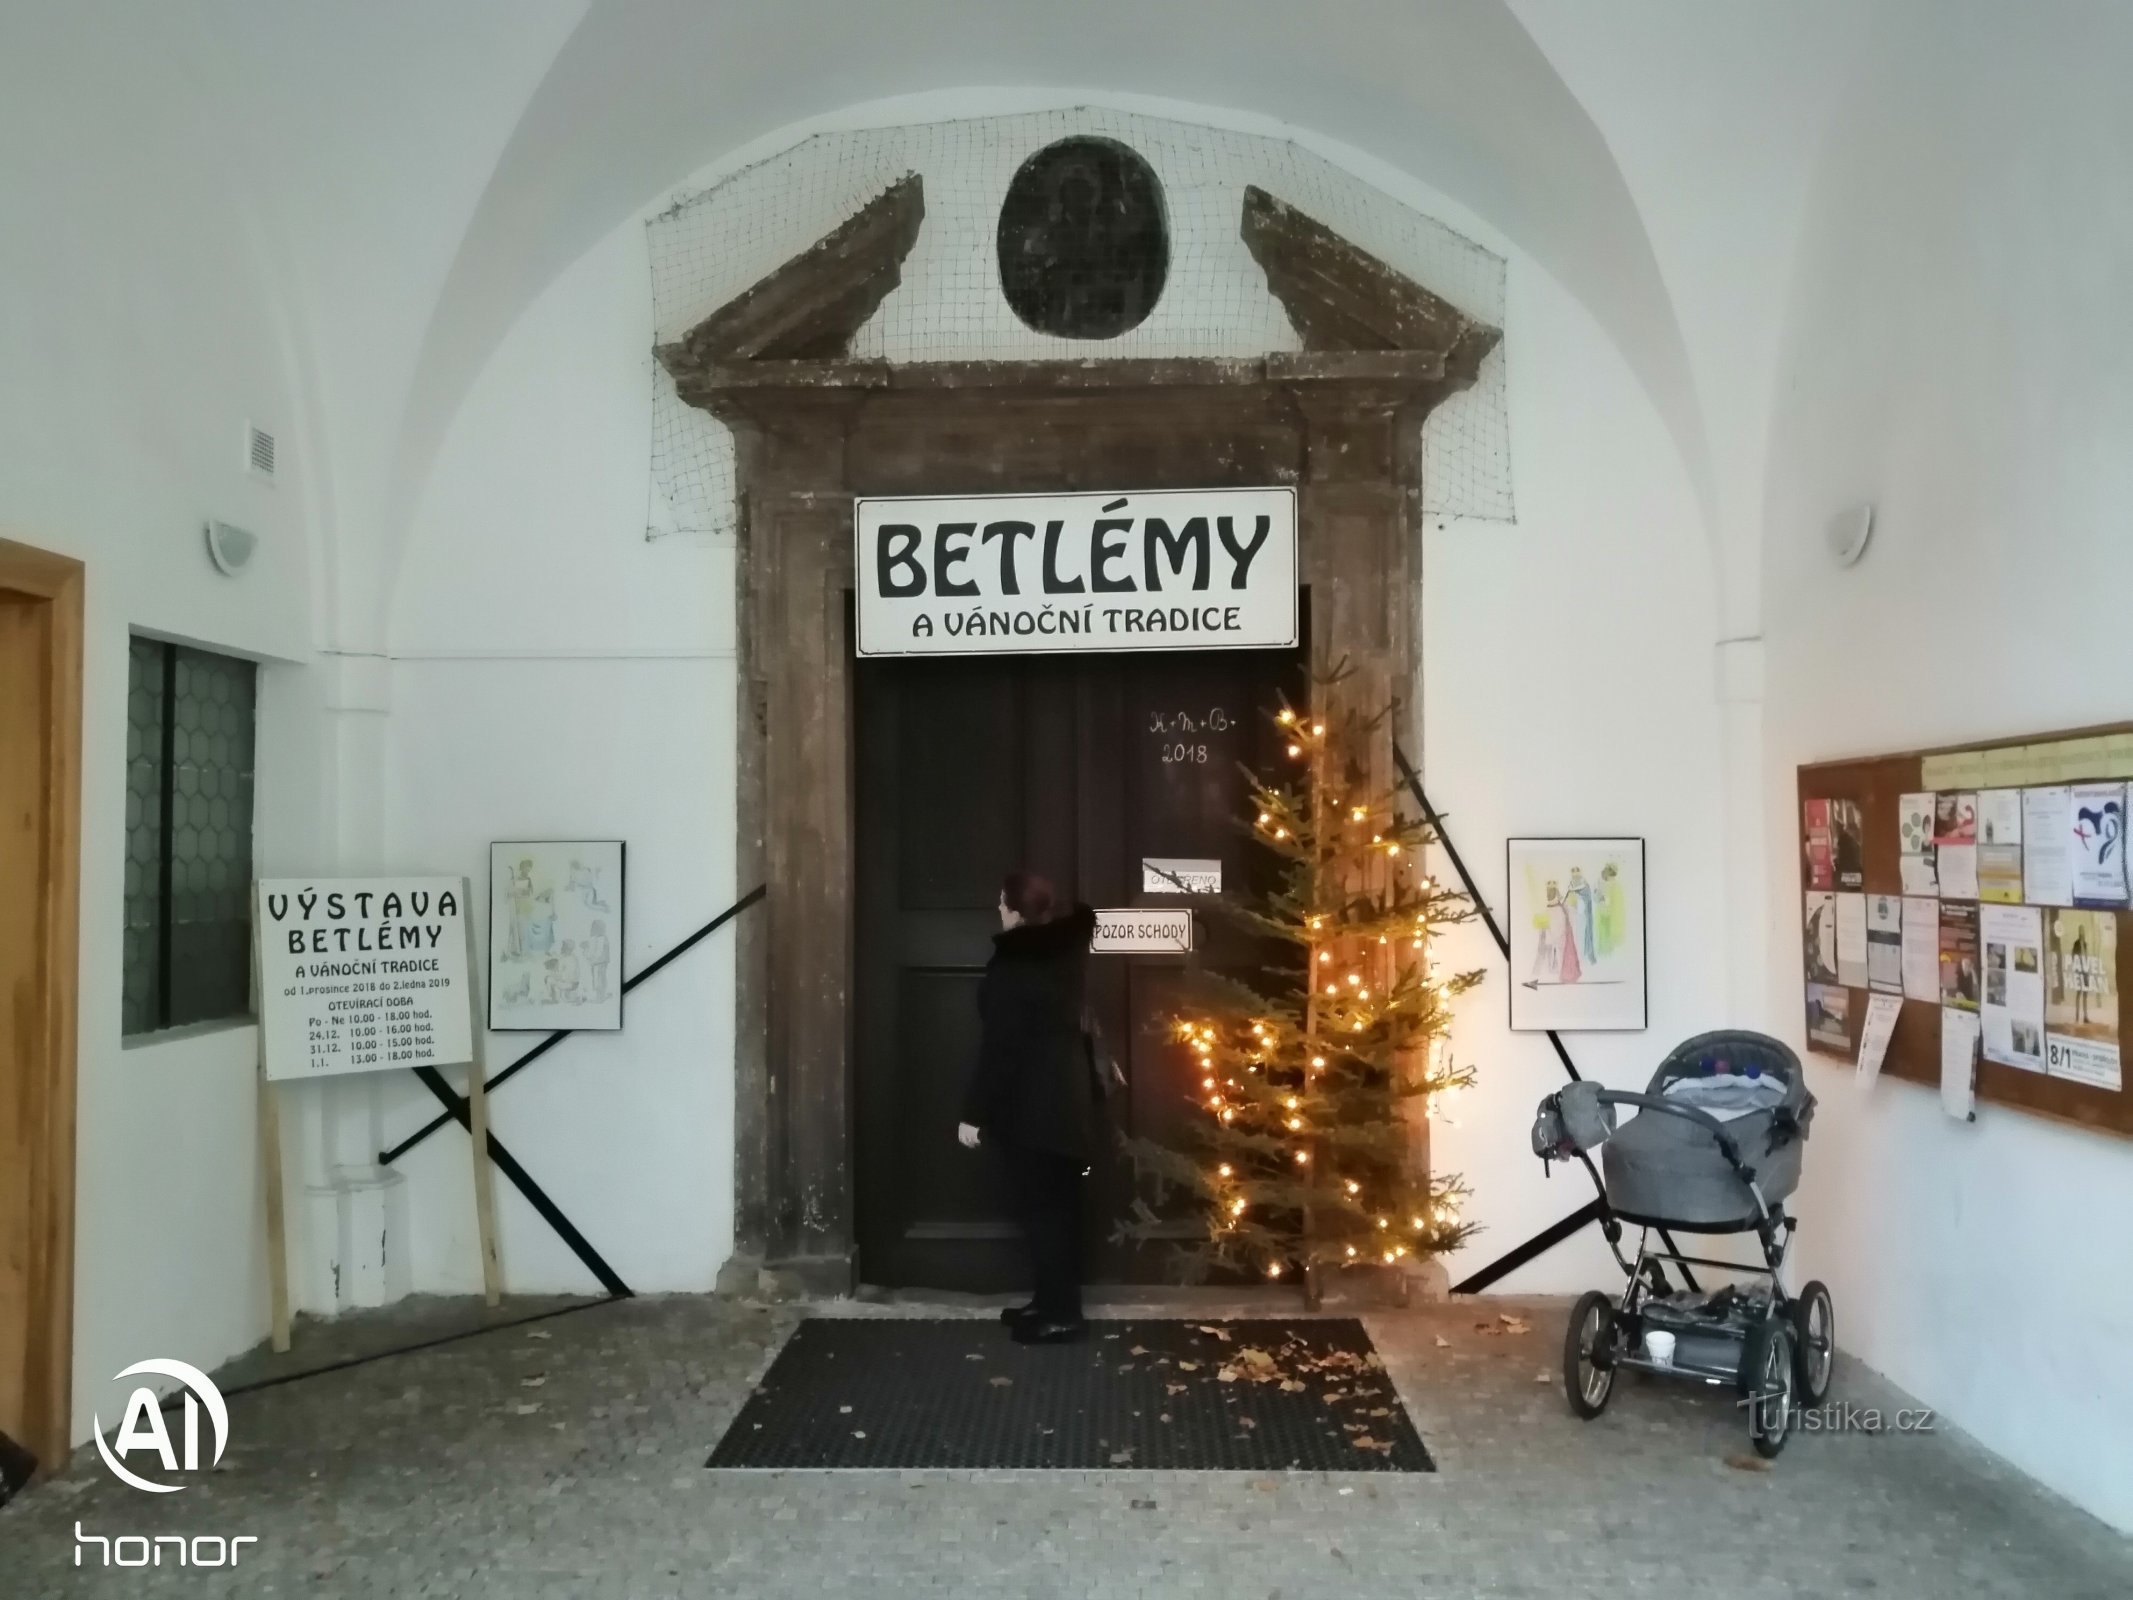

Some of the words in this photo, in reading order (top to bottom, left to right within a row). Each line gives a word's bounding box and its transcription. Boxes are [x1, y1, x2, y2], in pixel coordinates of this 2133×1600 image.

[876, 497, 1271, 598] BETLÉMY
[912, 613, 933, 637] A
[944, 603, 1094, 636] VÁNOČNÍ
[1102, 606, 1242, 633] TRADICE
[1162, 744, 1207, 764] 2018
[268, 887, 457, 921] VÝSTAVA
[288, 921, 442, 954] BETLÉMY
[1095, 924, 1135, 939] POZOR
[1138, 924, 1185, 939] SCHODY
[296, 966, 305, 978] A
[310, 958, 376, 978] VÁNOČNÍ
[381, 958, 439, 974] TRADICE
[284, 986, 296, 996] od
[353, 982, 375, 992] 2018
[379, 981, 390, 991] do
[429, 978, 450, 988] 2019
[386, 997, 413, 1007] DOBA
[309, 1017, 322, 1027] Po
[332, 1016, 344, 1026] Ne
[349, 1014, 375, 1024] 10.00
[385, 1012, 410, 1021] 18.00
[413, 1010, 432, 1020] hod.
[309, 1030, 340, 1041] 24.12.
[350, 1027, 376, 1038] 10.00
[386, 1025, 411, 1035] 16.00
[414, 1023, 433, 1032] hod.
[310, 1044, 341, 1055] 31.12.
[351, 1041, 376, 1051] 10.00
[387, 1038, 412, 1048] 15.00
[415, 1036, 434, 1046] hod.
[311, 1058, 329, 1068] 1.1.
[351, 1054, 377, 1064] 13.00
[387, 1051, 412, 1061] 18.00
[415, 1049, 434, 1058] hod.
[2050, 1044, 2071, 1069] 8/1
